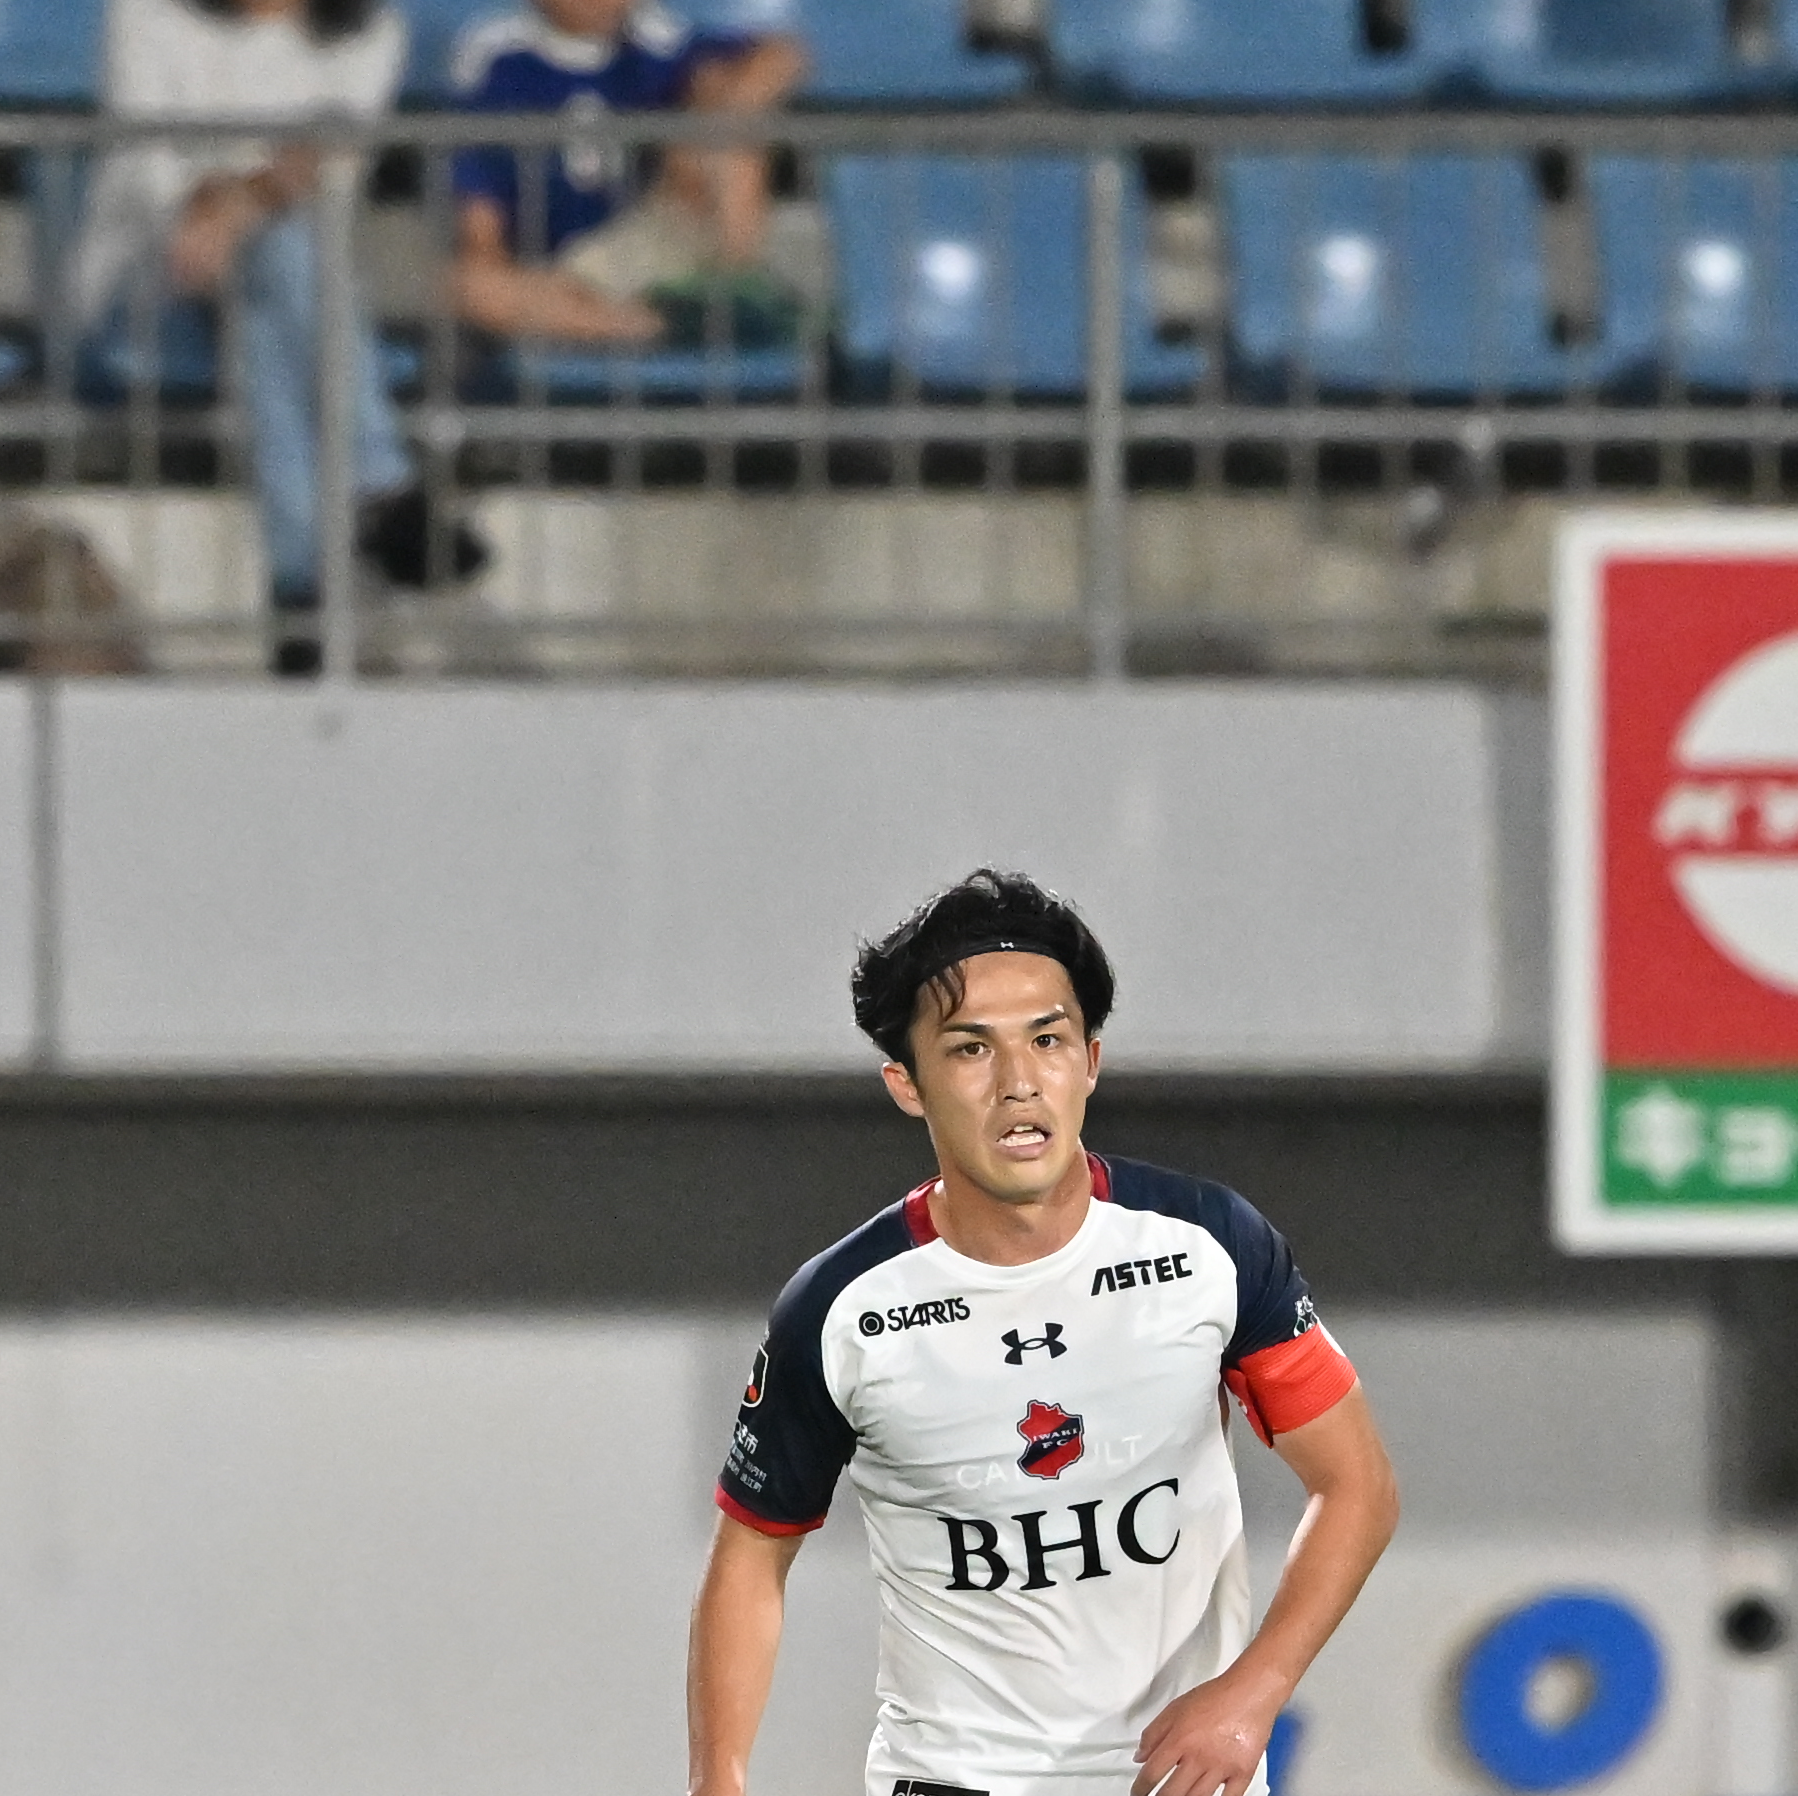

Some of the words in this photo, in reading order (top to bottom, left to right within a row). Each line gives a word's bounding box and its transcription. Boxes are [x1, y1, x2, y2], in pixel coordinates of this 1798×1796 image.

[1091, 1252, 1193, 1296] ASTEC
[1033, 1428, 1077, 1442] IWAKI
[1042, 1439, 1069, 1449] FC
[938, 1478, 1181, 1592] BHC
